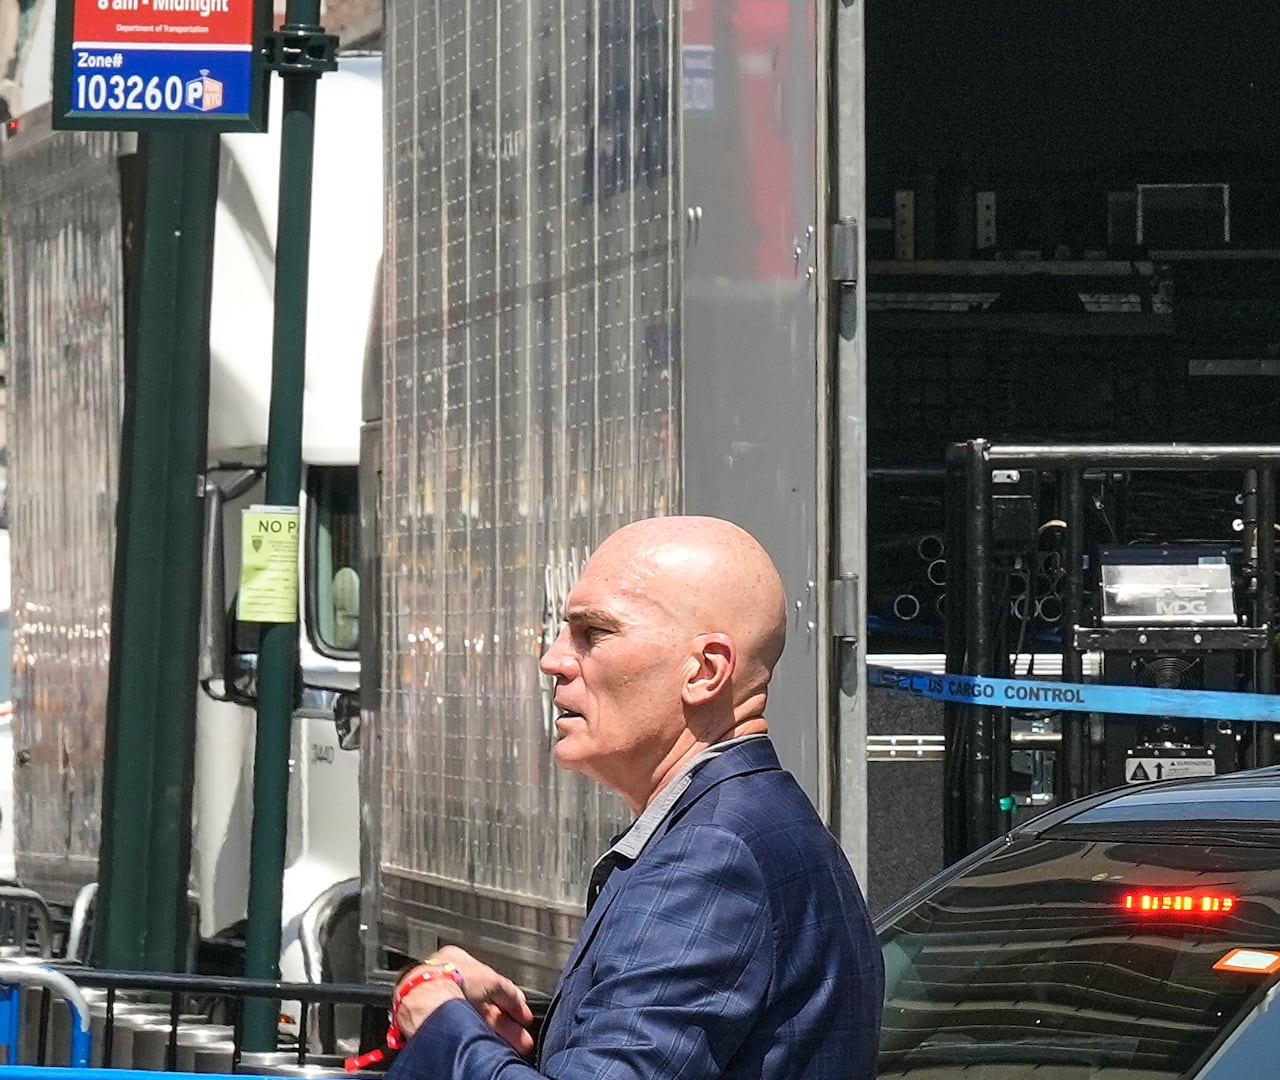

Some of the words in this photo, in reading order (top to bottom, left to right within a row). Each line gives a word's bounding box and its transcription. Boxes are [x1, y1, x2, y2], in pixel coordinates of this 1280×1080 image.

[152, 0, 229, 17] Midnight
[116, 24, 154, 33] Department
[155, 24, 162, 33] of
[163, 24, 209, 34] Transportation
[77, 52, 123, 68] Zone#
[77, 74, 184, 111] 103260
[258, 520, 282, 533] NO
[287, 521, 297, 534] P
[1156, 600, 1208, 615] MDG
[928, 677, 944, 694] US
[949, 681, 995, 699] CARGO
[1004, 684, 1086, 704] CONTROL
